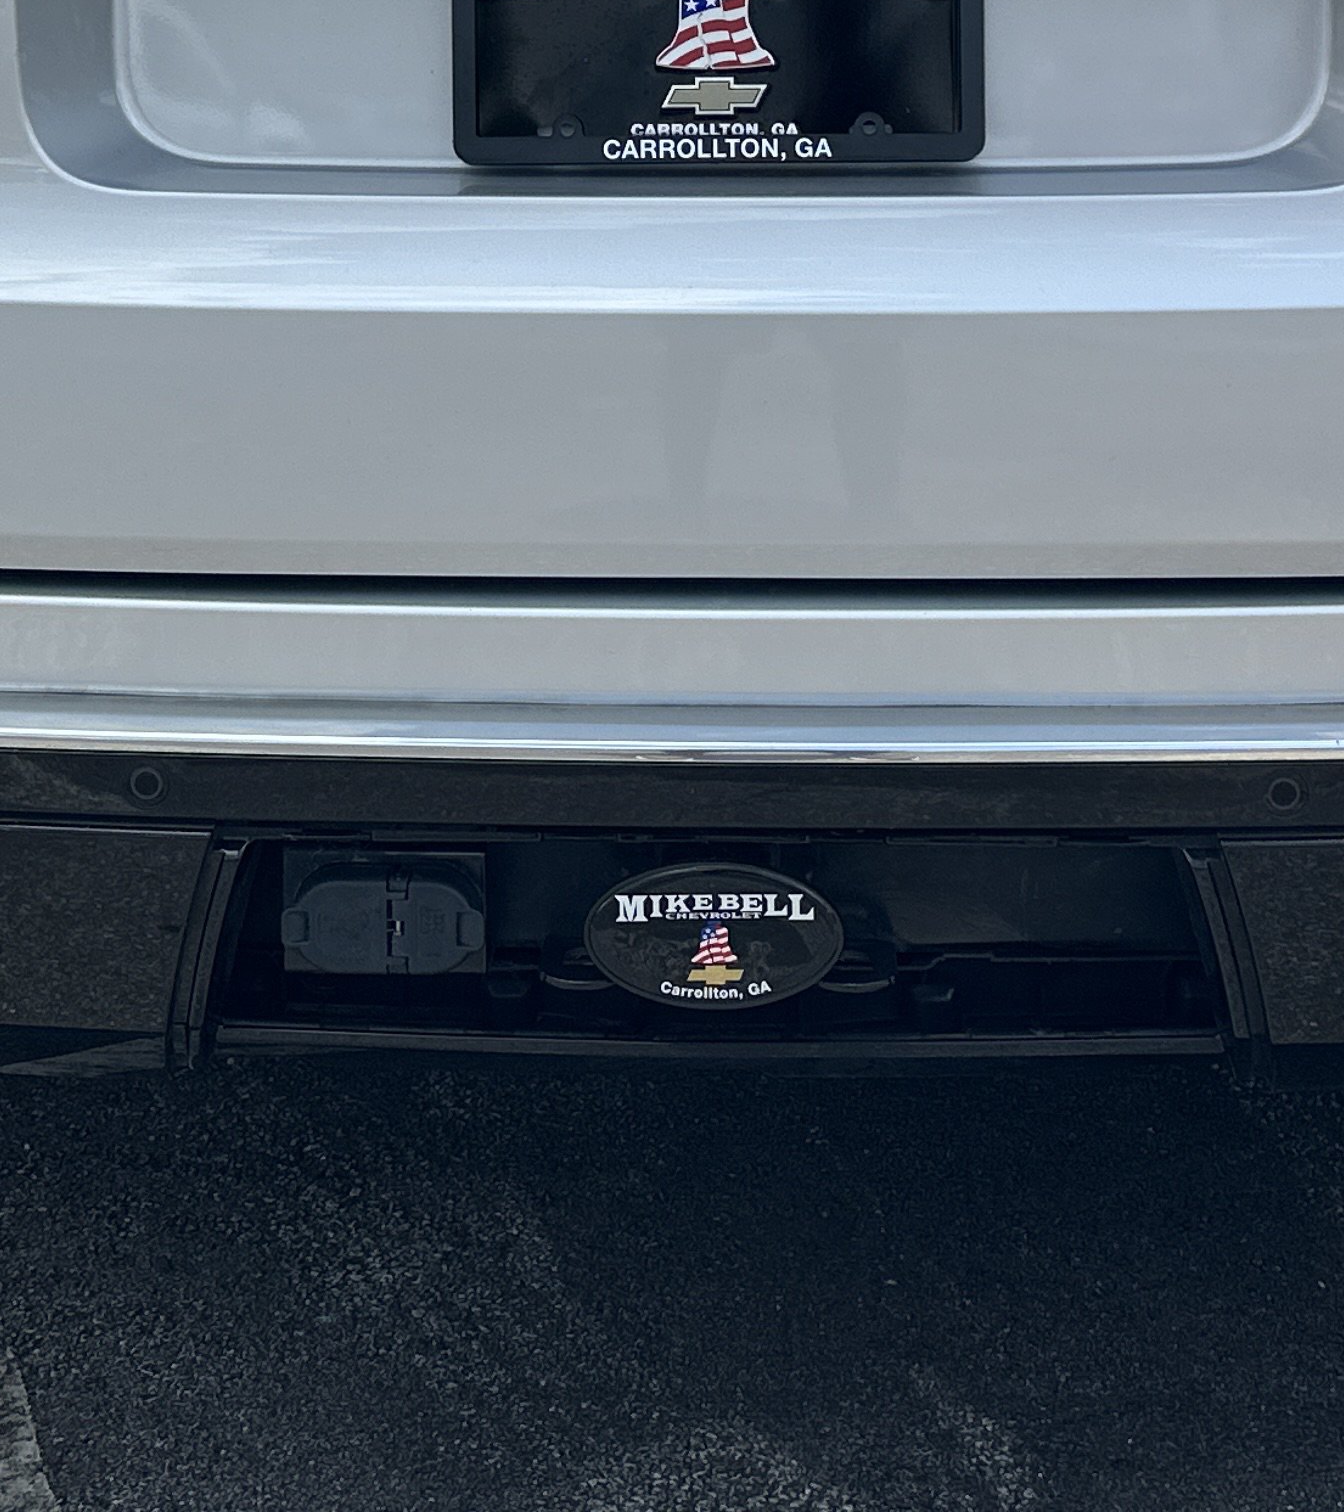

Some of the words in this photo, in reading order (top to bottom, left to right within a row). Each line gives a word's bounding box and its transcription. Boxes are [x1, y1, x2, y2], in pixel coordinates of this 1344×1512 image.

[603, 138, 787, 162] CARROLLTON,
[794, 138, 833, 159] GA
[614, 893, 713, 922] MIKE
[718, 893, 815, 921] BELL
[666, 912, 762, 920] CHEVROLET
[660, 981, 744, 1000] Carrollton,
[747, 980, 772, 996] GA
